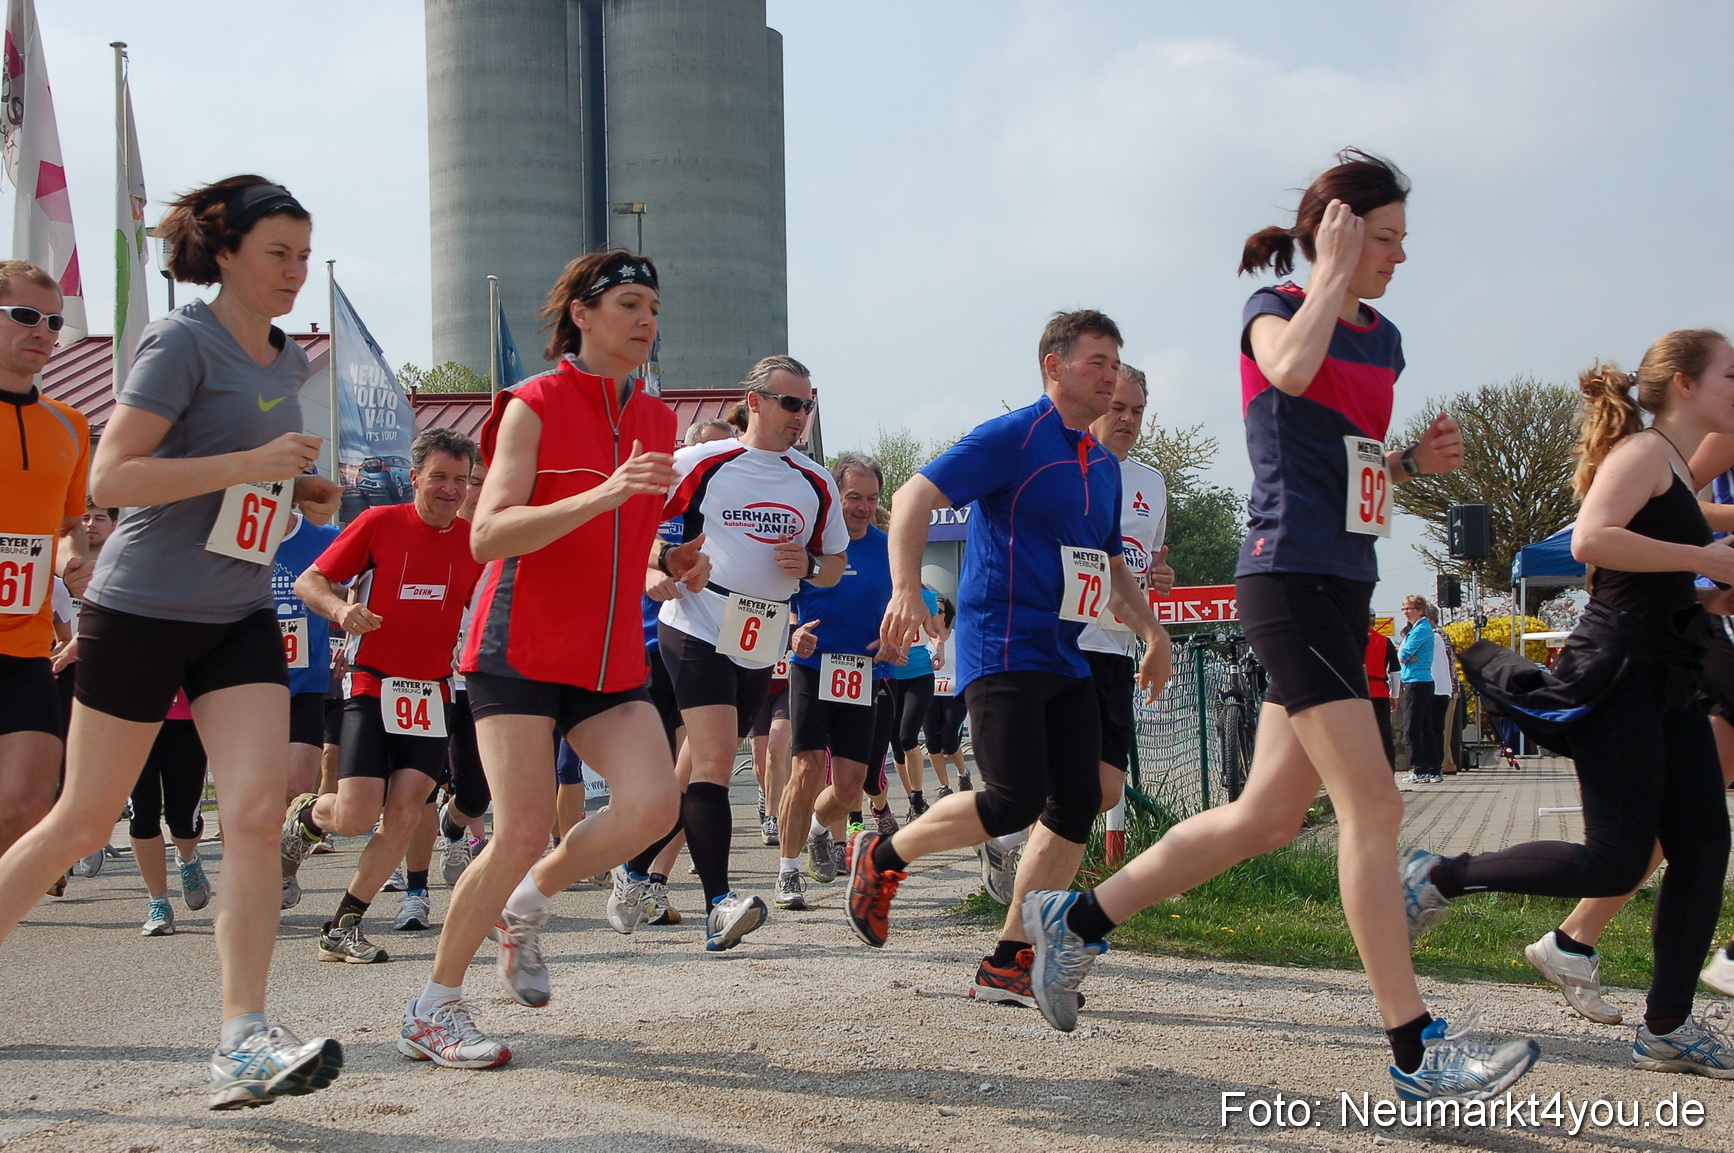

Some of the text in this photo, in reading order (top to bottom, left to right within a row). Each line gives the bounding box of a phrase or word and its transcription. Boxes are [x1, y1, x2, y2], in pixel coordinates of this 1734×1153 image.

[349, 362, 392, 389] NEUE
[365, 409, 401, 429] V40.
[1360, 467, 1386, 525] 92
[236, 492, 278, 554] 67
[722, 509, 791, 524] GERHART
[723, 520, 797, 535] Autohaus JÄNIG
[1072, 550, 1099, 562] MEYER
[1124, 556, 1144, 569] NIG
[1073, 560, 1100, 570] WERBUNG
[0, 560, 34, 607] 61
[413, 588, 433, 596] DEHN
[1077, 572, 1103, 618] 72
[738, 598, 767, 611] MEYER
[738, 605, 766, 616] WERBUNG
[739, 616, 761, 652] 6
[831, 654, 856, 662] MEYER
[392, 680, 421, 689] MEYER
[392, 687, 422, 695] WERBUNG
[831, 668, 863, 700] 68
[936, 680, 948, 692] 77
[395, 696, 431, 731] 94
